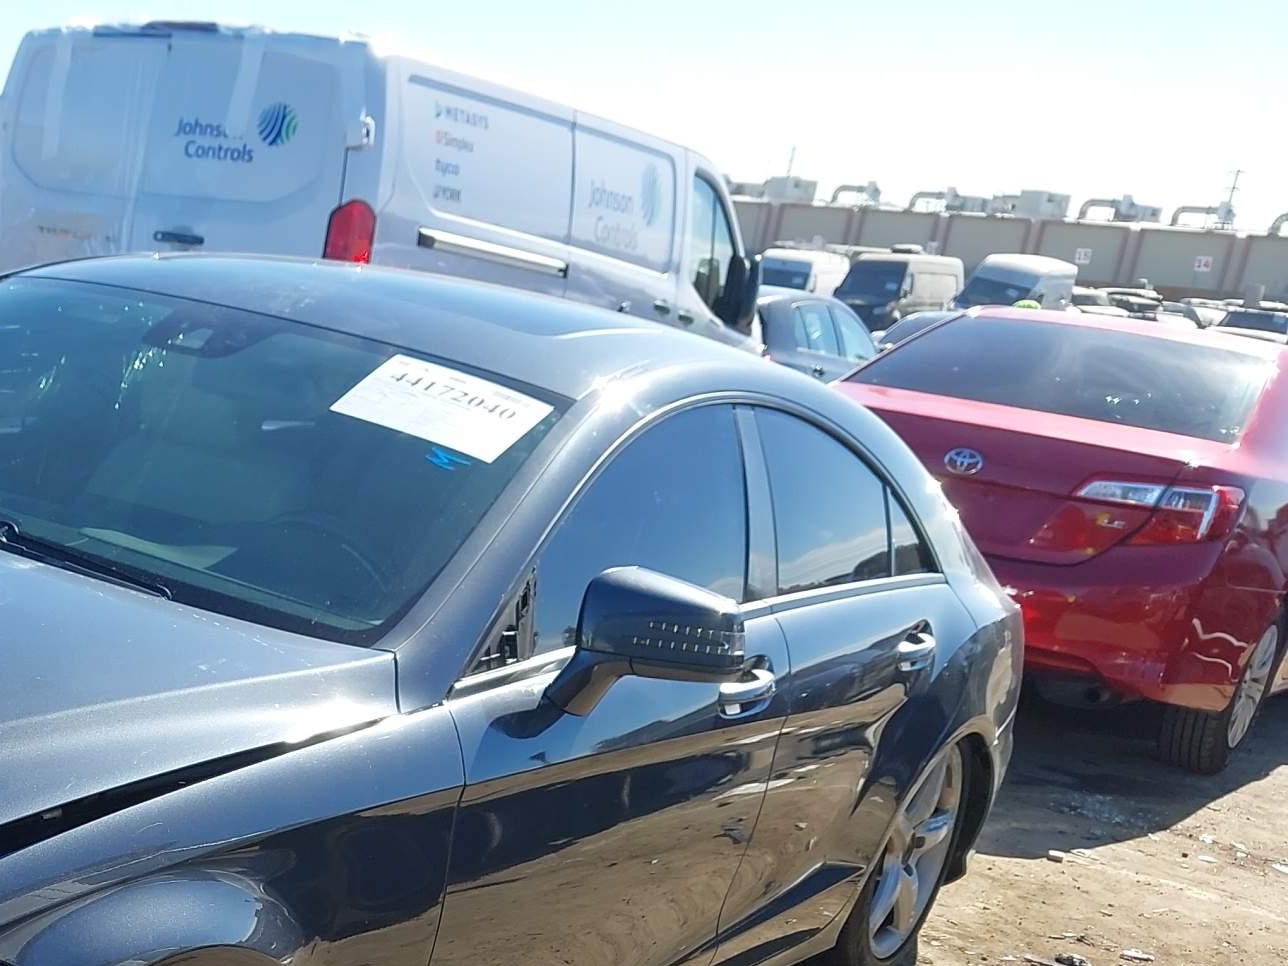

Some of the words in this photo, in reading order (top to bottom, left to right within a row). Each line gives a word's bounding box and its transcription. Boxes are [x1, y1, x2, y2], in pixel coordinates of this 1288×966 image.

[184, 140, 254, 163] Controls
[587, 178, 633, 214] Johnson
[389, 371, 518, 421] 44172040
